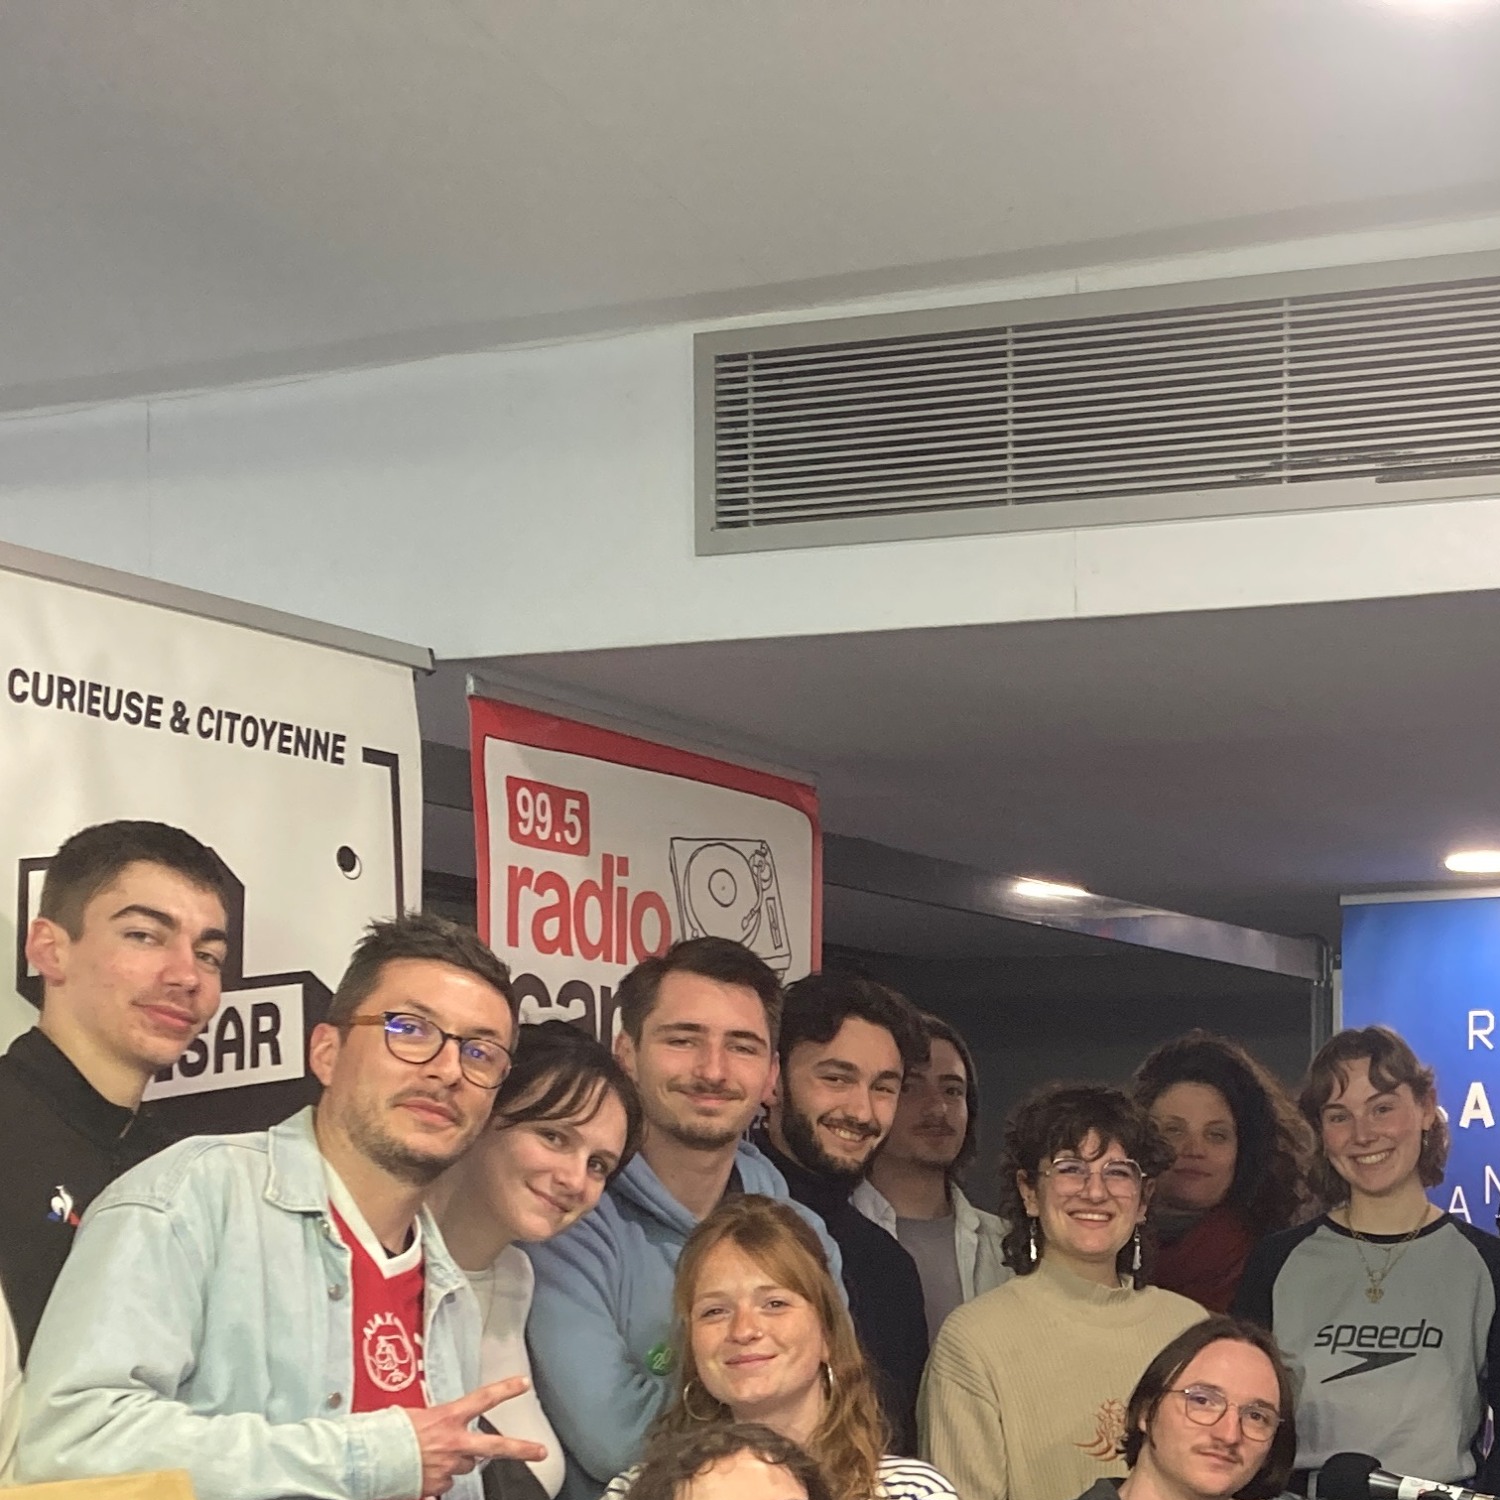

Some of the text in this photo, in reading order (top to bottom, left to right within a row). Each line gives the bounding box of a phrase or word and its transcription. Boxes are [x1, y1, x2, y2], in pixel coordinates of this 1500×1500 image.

[7, 668, 347, 765] CURIEUSE & CITOYENNE
[516, 786, 583, 846] 99.5
[506, 853, 673, 966] radio
[1313, 1318, 1444, 1355] speedo
